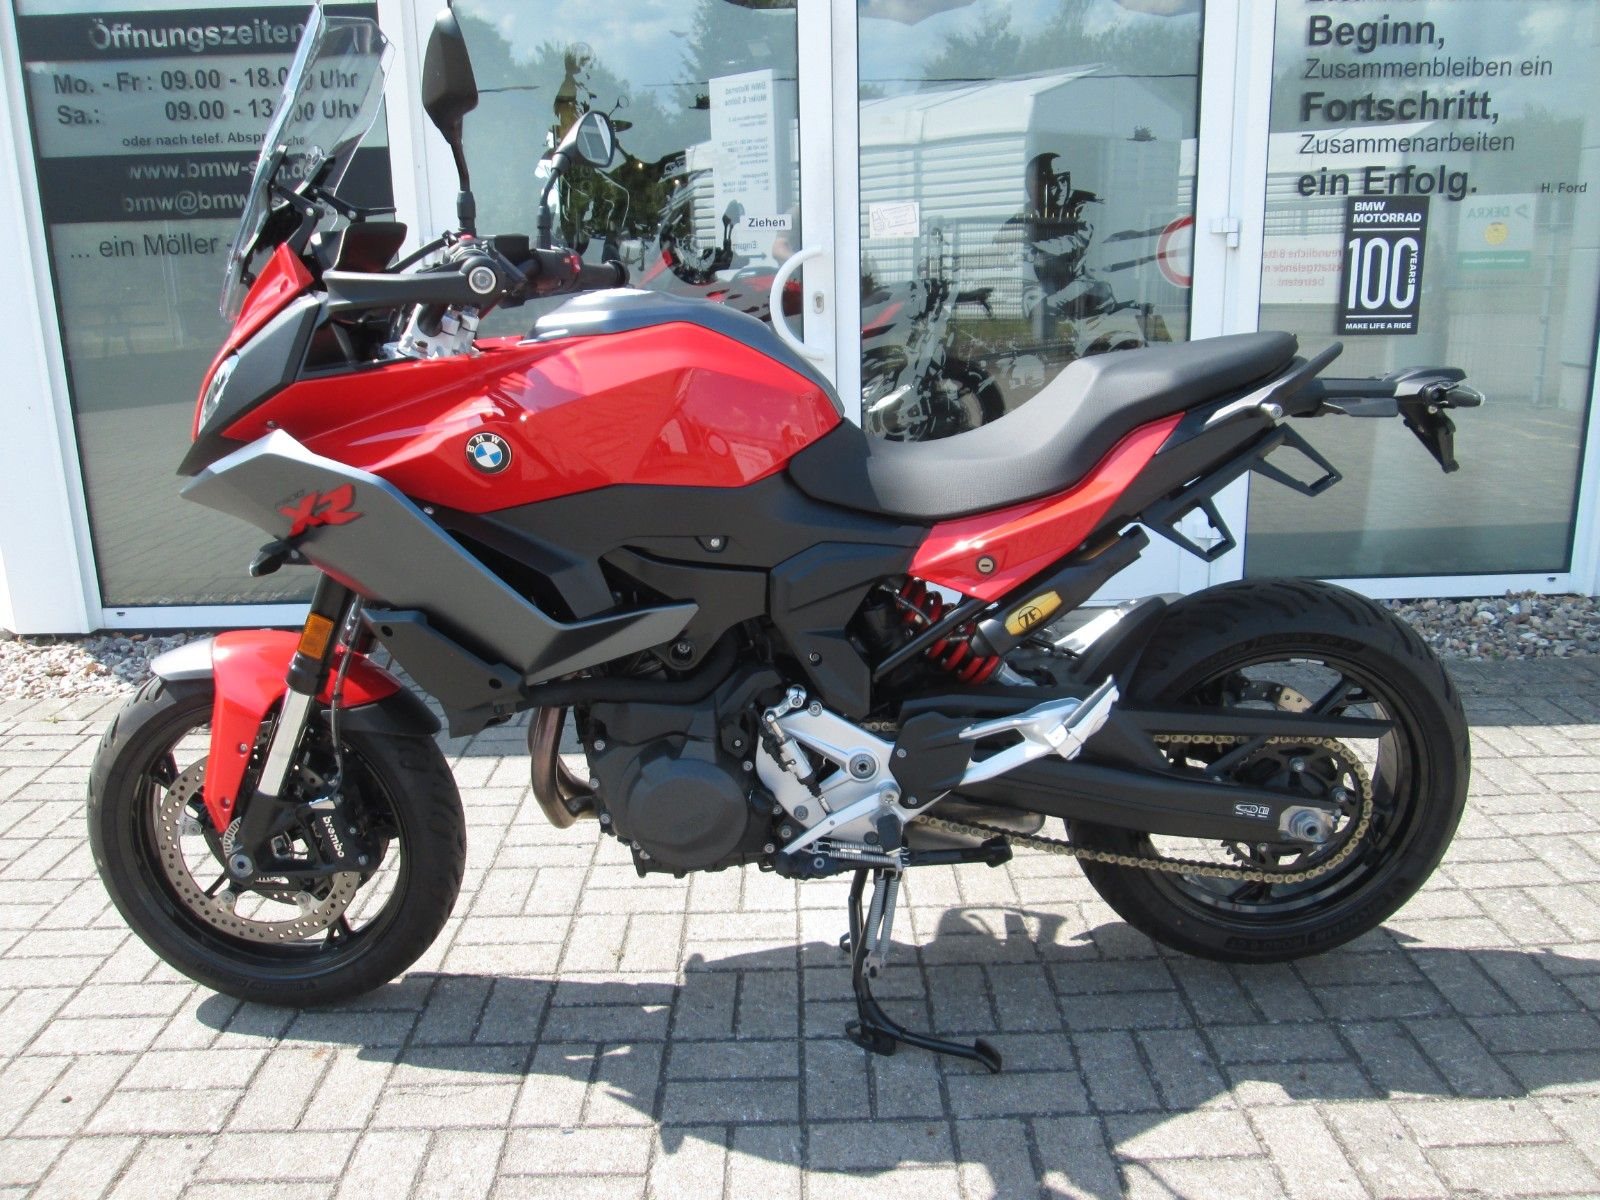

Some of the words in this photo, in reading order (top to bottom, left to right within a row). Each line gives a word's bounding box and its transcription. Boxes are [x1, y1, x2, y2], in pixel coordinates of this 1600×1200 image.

[90, 18, 306, 52] Öffnungszeiten
[1308, 14, 1445, 53] Beginn,
[1304, 56, 1512, 79] Zusammenbleiben
[1520, 55, 1553, 76] ein
[54, 73, 95, 94] Mo.
[160, 69, 221, 91] 09.00
[320, 69, 358, 89] Uhr
[57, 105, 100, 125] Sa.:
[165, 99, 225, 121] 09.00
[322, 99, 359, 119] Uhr
[1303, 90, 1499, 125] Fortschritt,
[122, 134, 152, 147] oder
[156, 132, 188, 146] nach
[191, 132, 224, 145] telef.
[228, 131, 305, 147] Absprche
[1300, 132, 1515, 154] Zusammenarbeiten
[1298, 166, 1350, 196] ein
[1364, 165, 1477, 201] Erfolg.
[1541, 183, 1553, 193] H.
[1558, 181, 1588, 193] Ford
[1353, 212, 1422, 223] MOTORRAD
[1354, 201, 1386, 212] BMW
[748, 216, 786, 229] Ziehen
[99, 235, 135, 258] ein
[143, 232, 219, 256] Möller
[1348, 236, 1419, 310] 100
[1407, 250, 1419, 284] YEARS
[1345, 322, 1368, 330] MAKE
[1369, 322, 1385, 330] LIFE
[467, 434, 501, 453] BMW
[1017, 606, 1038, 629] ZF
[321, 815, 345, 859] brembo
